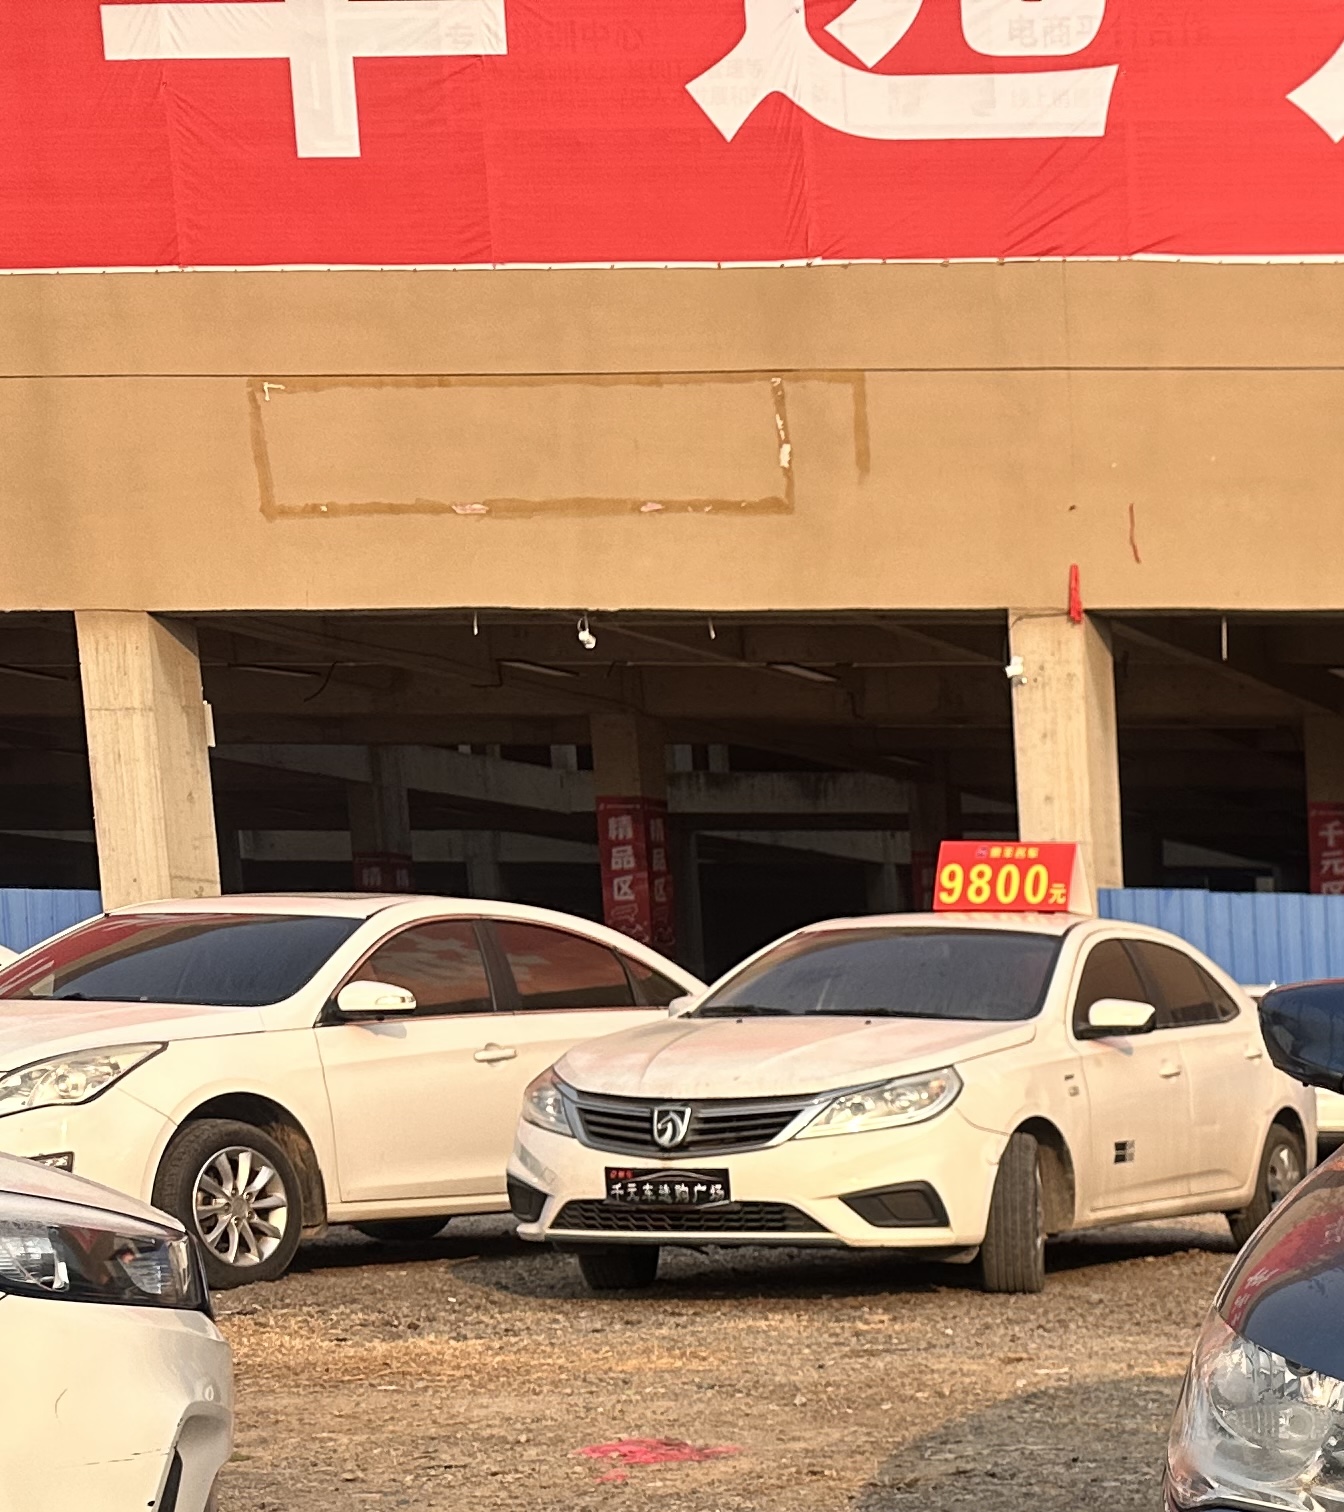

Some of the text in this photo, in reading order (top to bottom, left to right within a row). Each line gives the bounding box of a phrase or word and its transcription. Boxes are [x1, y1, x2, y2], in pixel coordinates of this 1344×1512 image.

[608, 814, 635, 901] 精品区
[938, 862, 1067, 905] 9800元
